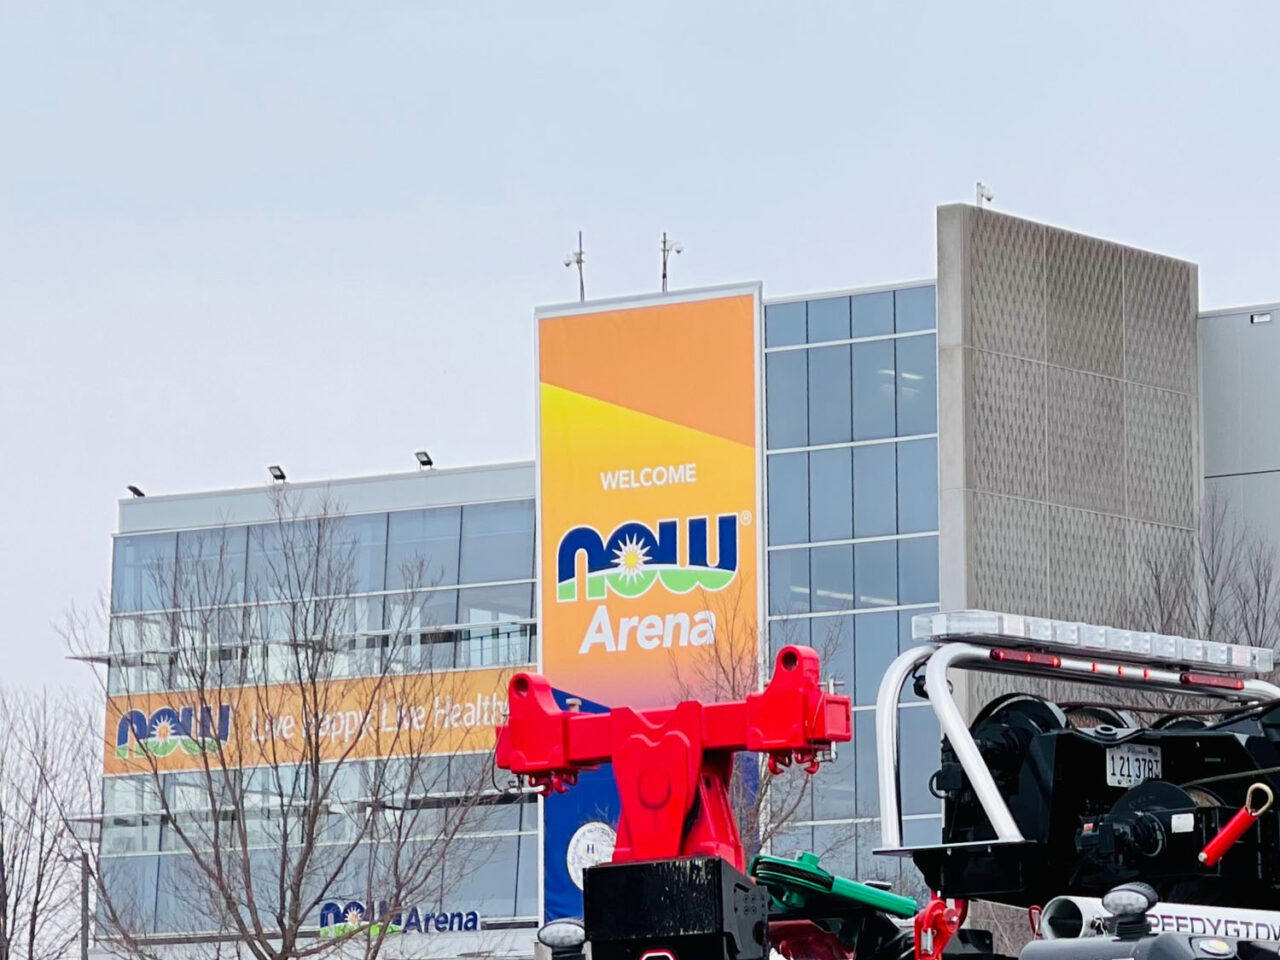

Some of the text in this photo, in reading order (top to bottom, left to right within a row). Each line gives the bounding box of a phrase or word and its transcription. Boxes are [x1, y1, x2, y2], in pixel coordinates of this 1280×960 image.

[600, 463, 697, 491] WELCOME
[578, 604, 717, 655] Arena
[402, 905, 480, 934] Arena
